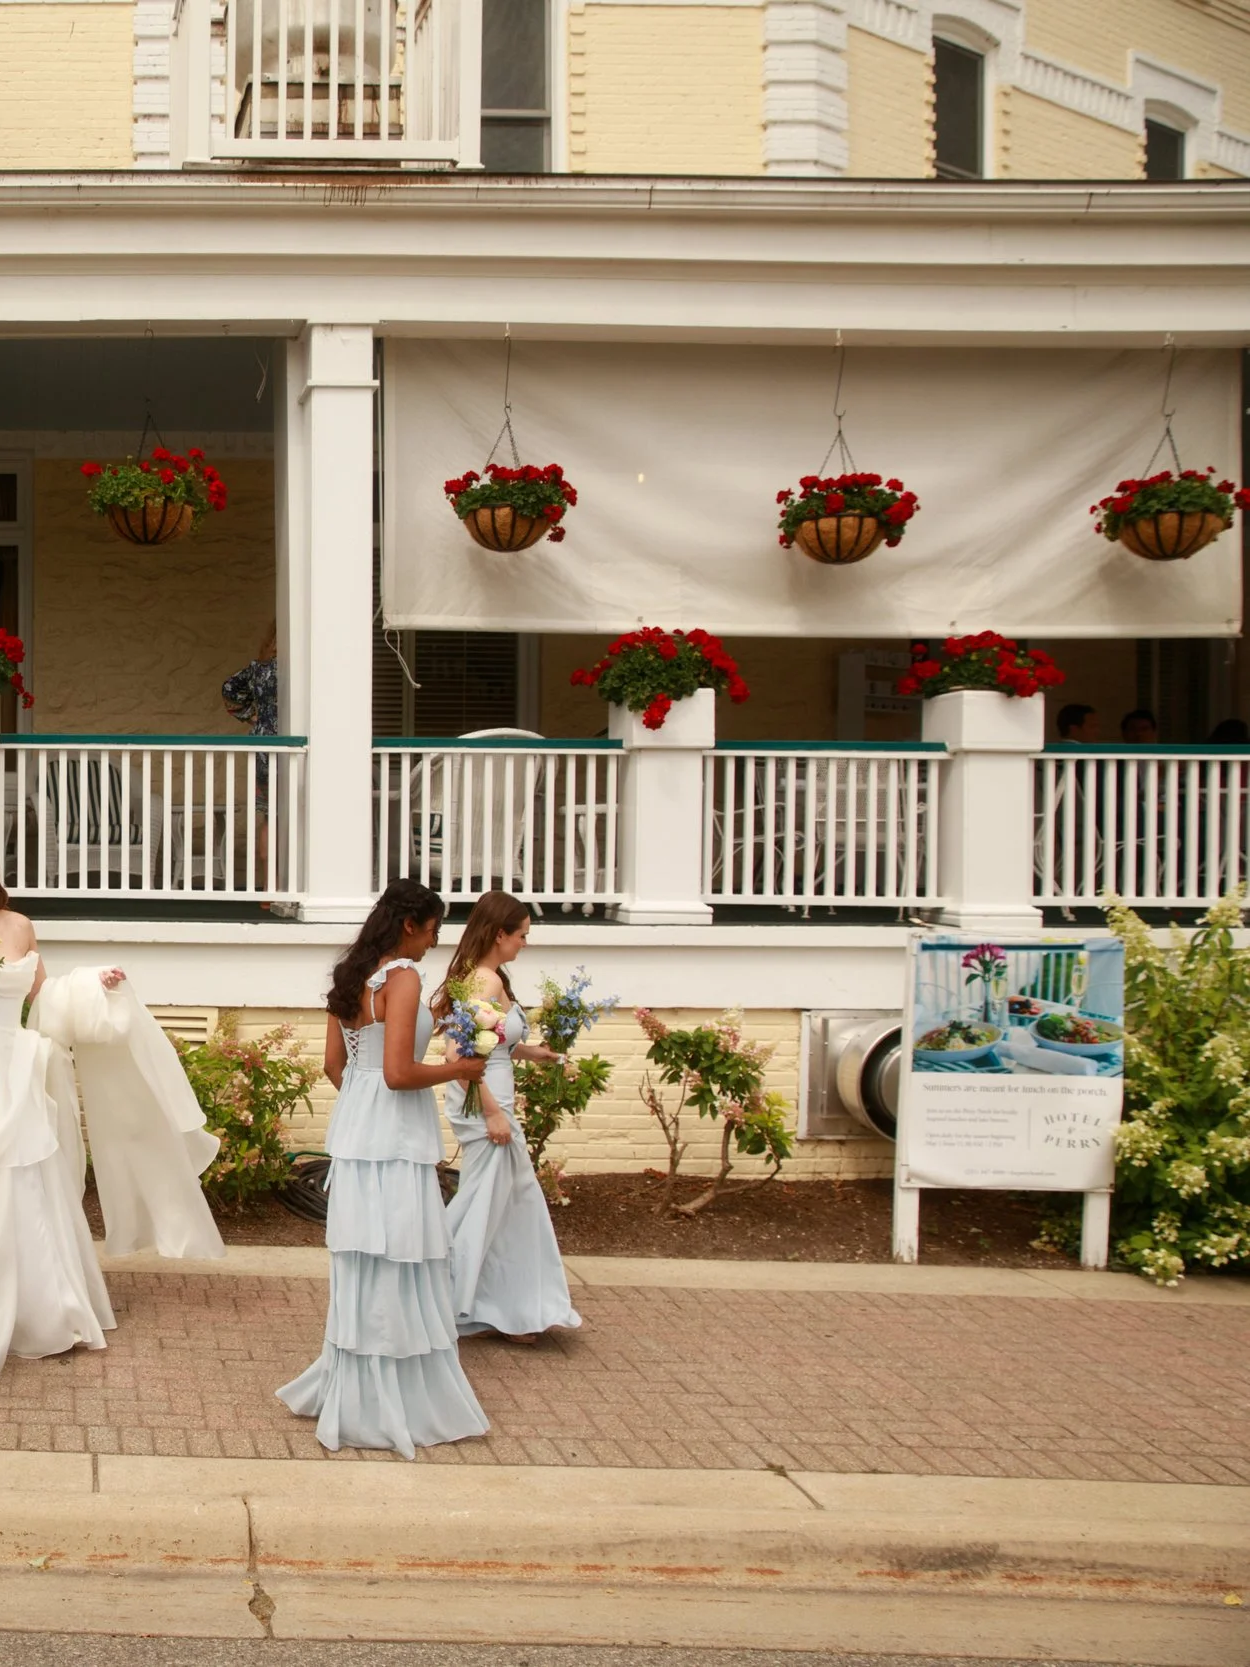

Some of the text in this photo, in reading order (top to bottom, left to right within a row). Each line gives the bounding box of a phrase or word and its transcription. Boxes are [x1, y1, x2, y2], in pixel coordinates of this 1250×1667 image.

[922, 1082, 962, 1093] Summers
[963, 1084, 979, 1093] are
[979, 1084, 1006, 1093] meant
[1007, 1083, 1020, 1093] for
[1022, 1084, 1046, 1094] lunch
[1047, 1086, 1059, 1094] on
[1060, 1085, 1074, 1095] the
[1042, 1111, 1102, 1128] HOTEL
[1042, 1133, 1102, 1149] PERRY
